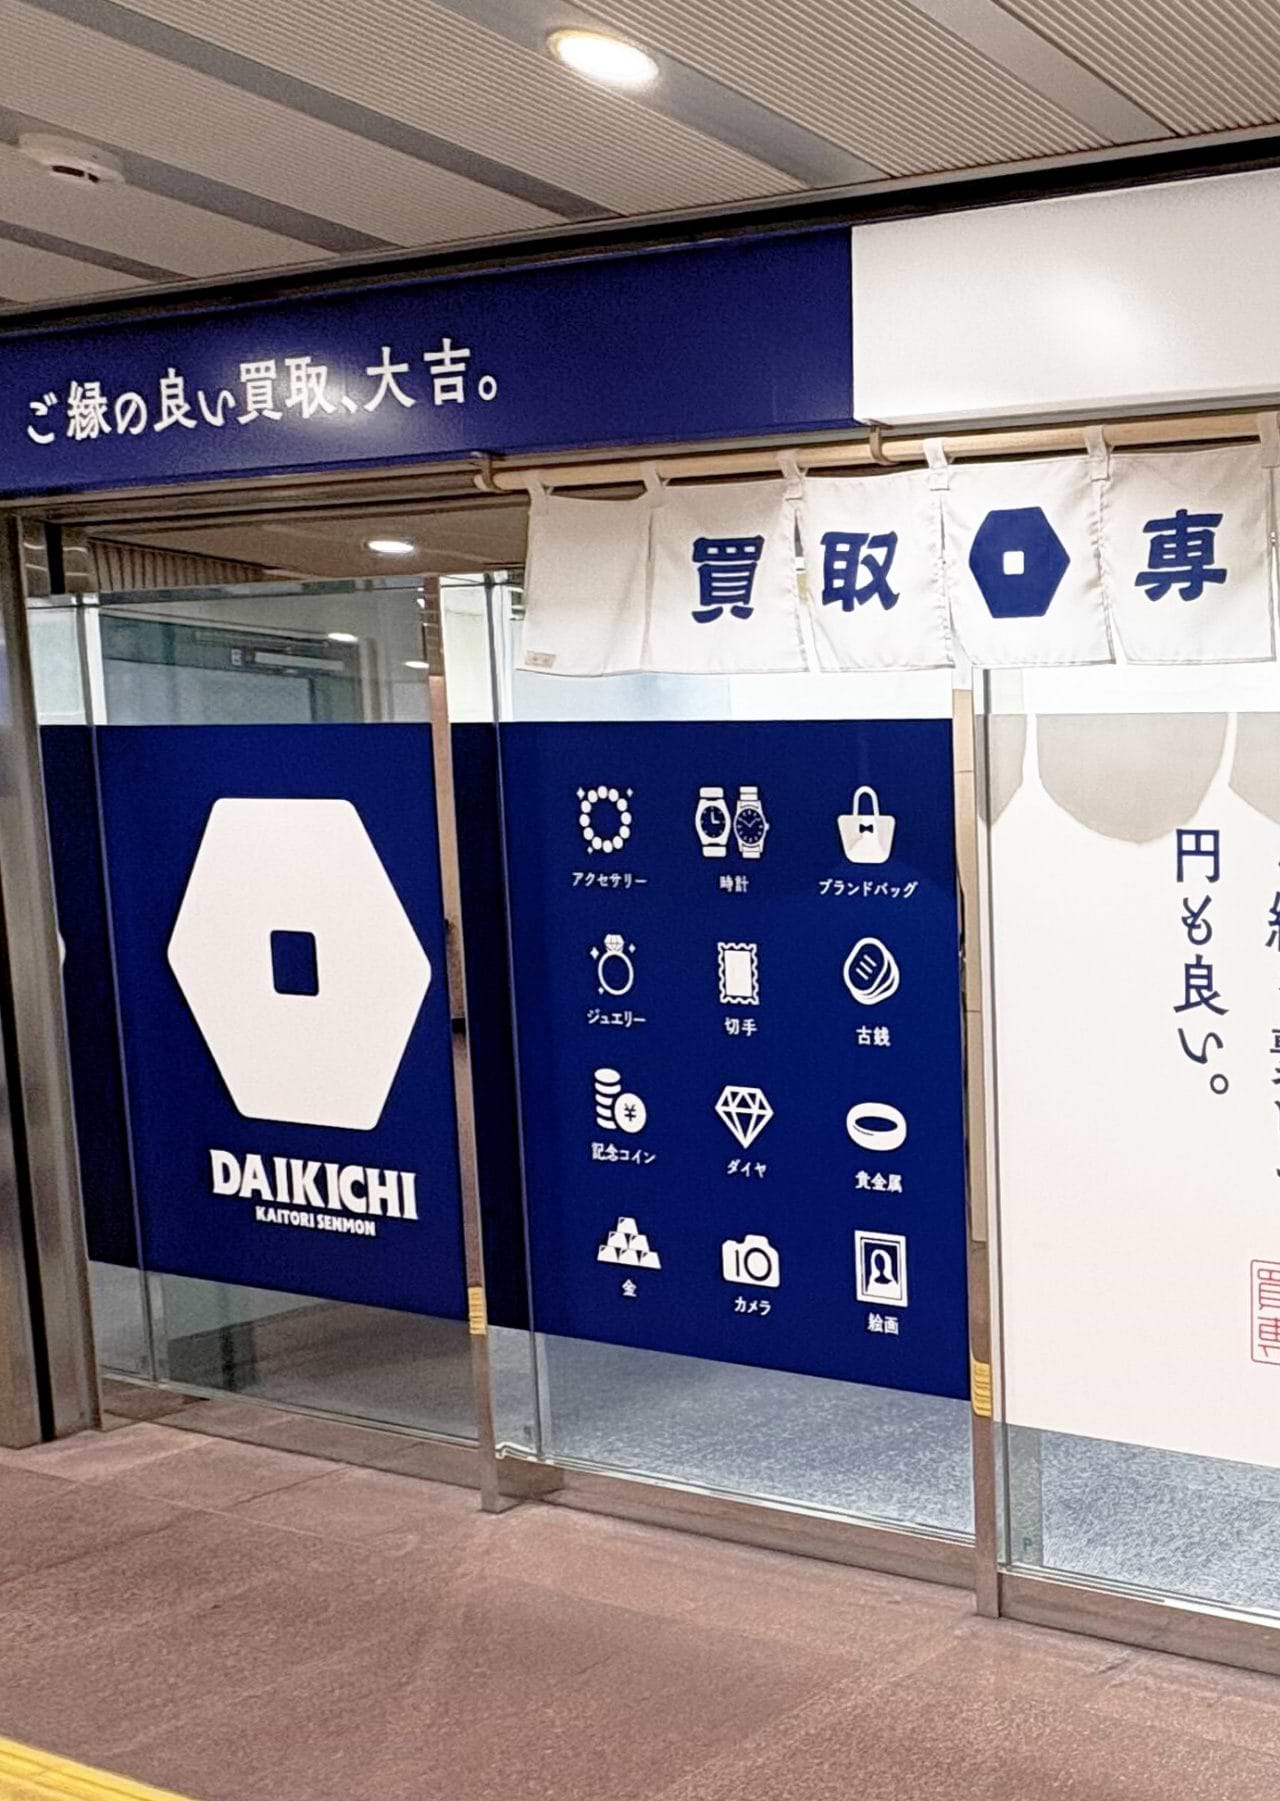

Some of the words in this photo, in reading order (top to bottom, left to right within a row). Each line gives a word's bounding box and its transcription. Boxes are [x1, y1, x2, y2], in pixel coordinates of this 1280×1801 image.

[27, 337, 498, 444] ご縁の良い買取、大吉。
[691, 530, 900, 624] 買取
[572, 871, 647, 889] アクセサリー
[719, 874, 749, 893] 時計
[818, 878, 919, 899] ブランドバッグ
[1173, 828, 1229, 1095] 円も良い。
[586, 1008, 647, 1028] ジュエリー
[724, 1016, 758, 1037] 切手
[855, 1025, 891, 1047] 古銭
[591, 1141, 656, 1165] 記念コイン
[727, 1158, 767, 1178] ダイヤ
[209, 1149, 419, 1220] DAIKICHI
[855, 1170, 903, 1193] 貴金属
[255, 1206, 315, 1229] KAITORI
[316, 1216, 376, 1237] SENMON
[621, 1278, 637, 1297] 金
[734, 1295, 772, 1316] カメラ
[867, 1312, 899, 1335] 絵画
